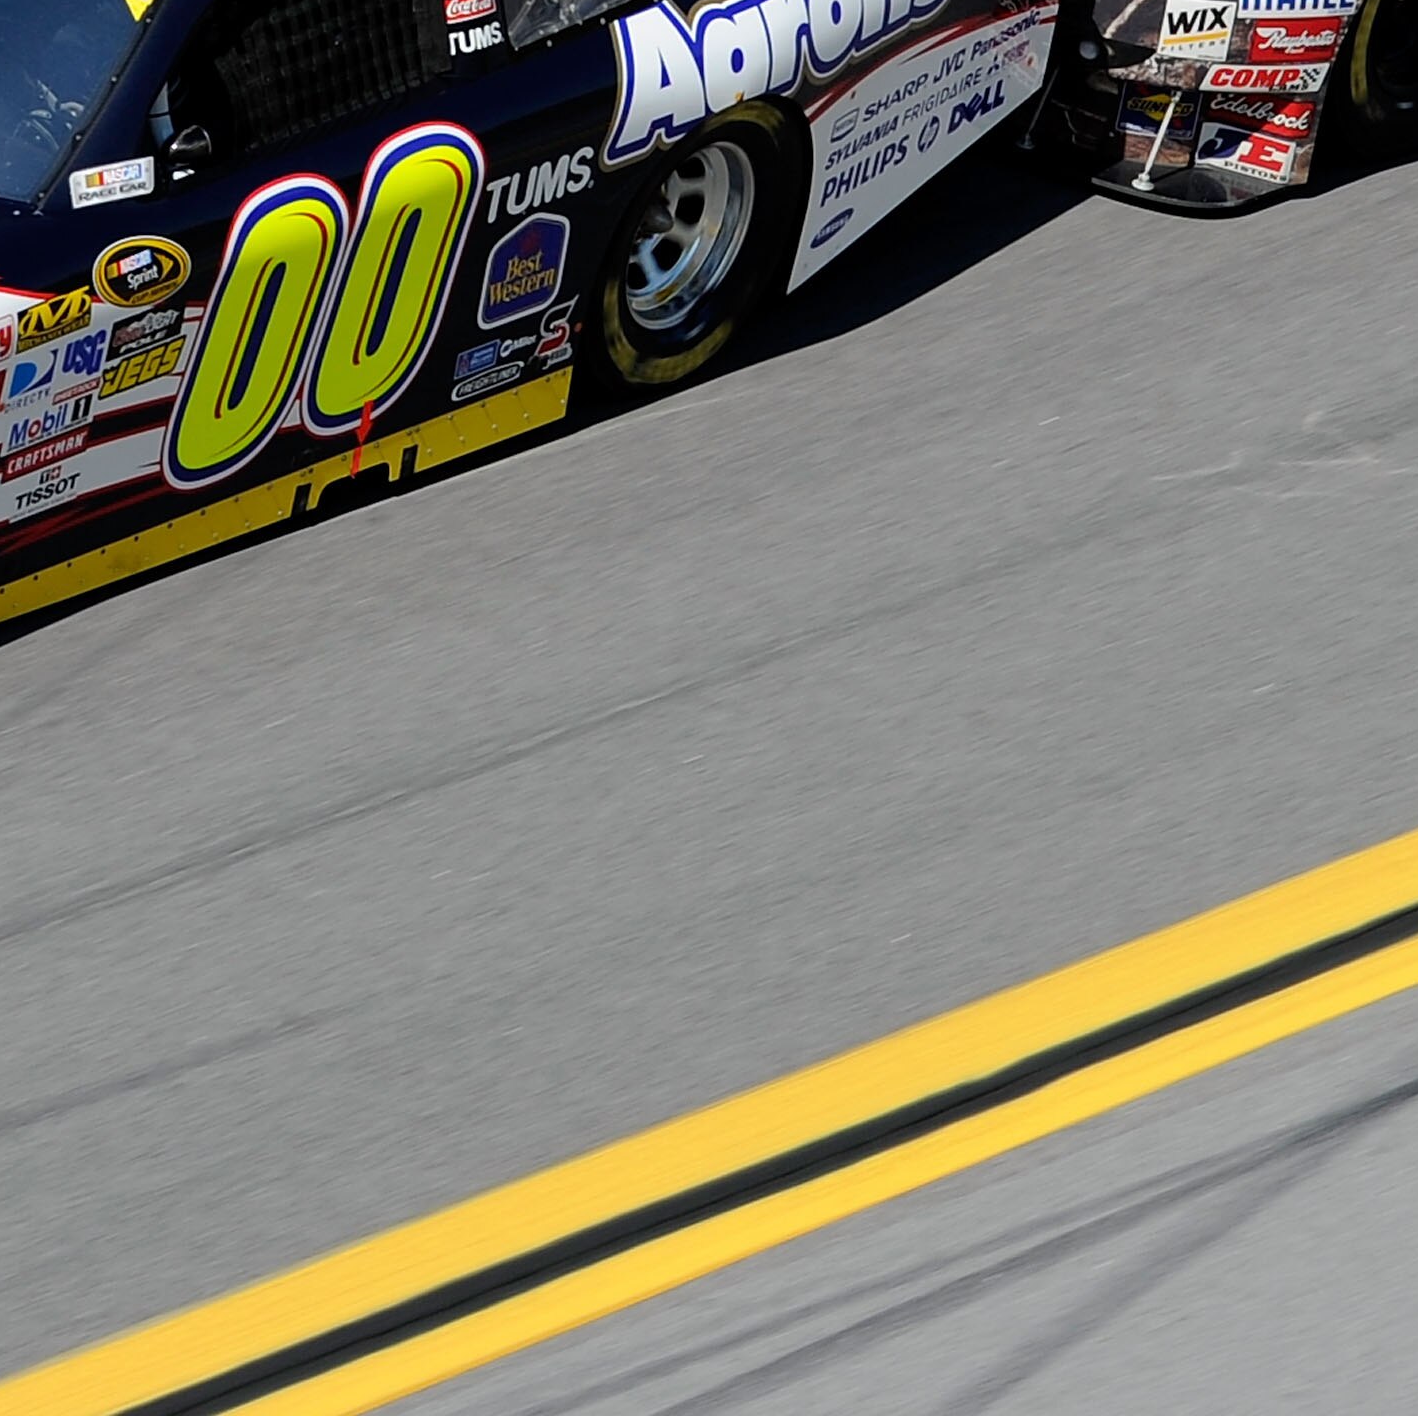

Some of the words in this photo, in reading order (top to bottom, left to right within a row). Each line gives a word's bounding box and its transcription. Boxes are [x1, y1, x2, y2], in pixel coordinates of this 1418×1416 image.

[448, 20, 504, 56] TUMS
[1167, 5, 1232, 35] WIX
[1160, 38, 1227, 53] FILTERS
[862, 72, 929, 123] SHARP
[932, 47, 966, 84] JVC
[1209, 67, 1302, 88] COMP
[824, 115, 899, 171] SYLVANIA
[901, 66, 984, 127] FRIGIDAIRE
[1209, 92, 1310, 130] Edelbrock
[819, 134, 910, 209] PHILIPS
[946, 78, 1006, 135] DELL
[1198, 128, 1290, 172] JE
[78, 186, 118, 201] RACE
[119, 181, 148, 194] CAR
[486, 146, 589, 224] TUMS
[126, 266, 159, 291] Sprint
[506, 249, 544, 281] Best
[167, 129, 479, 482] 00
[488, 268, 556, 307] Western
[62, 329, 107, 375] USG
[99, 338, 184, 400] JEGS
[8, 403, 68, 450] Mobil
[7, 431, 89, 474] CRAFTSMAN
[15, 472, 81, 510] TISSOT
